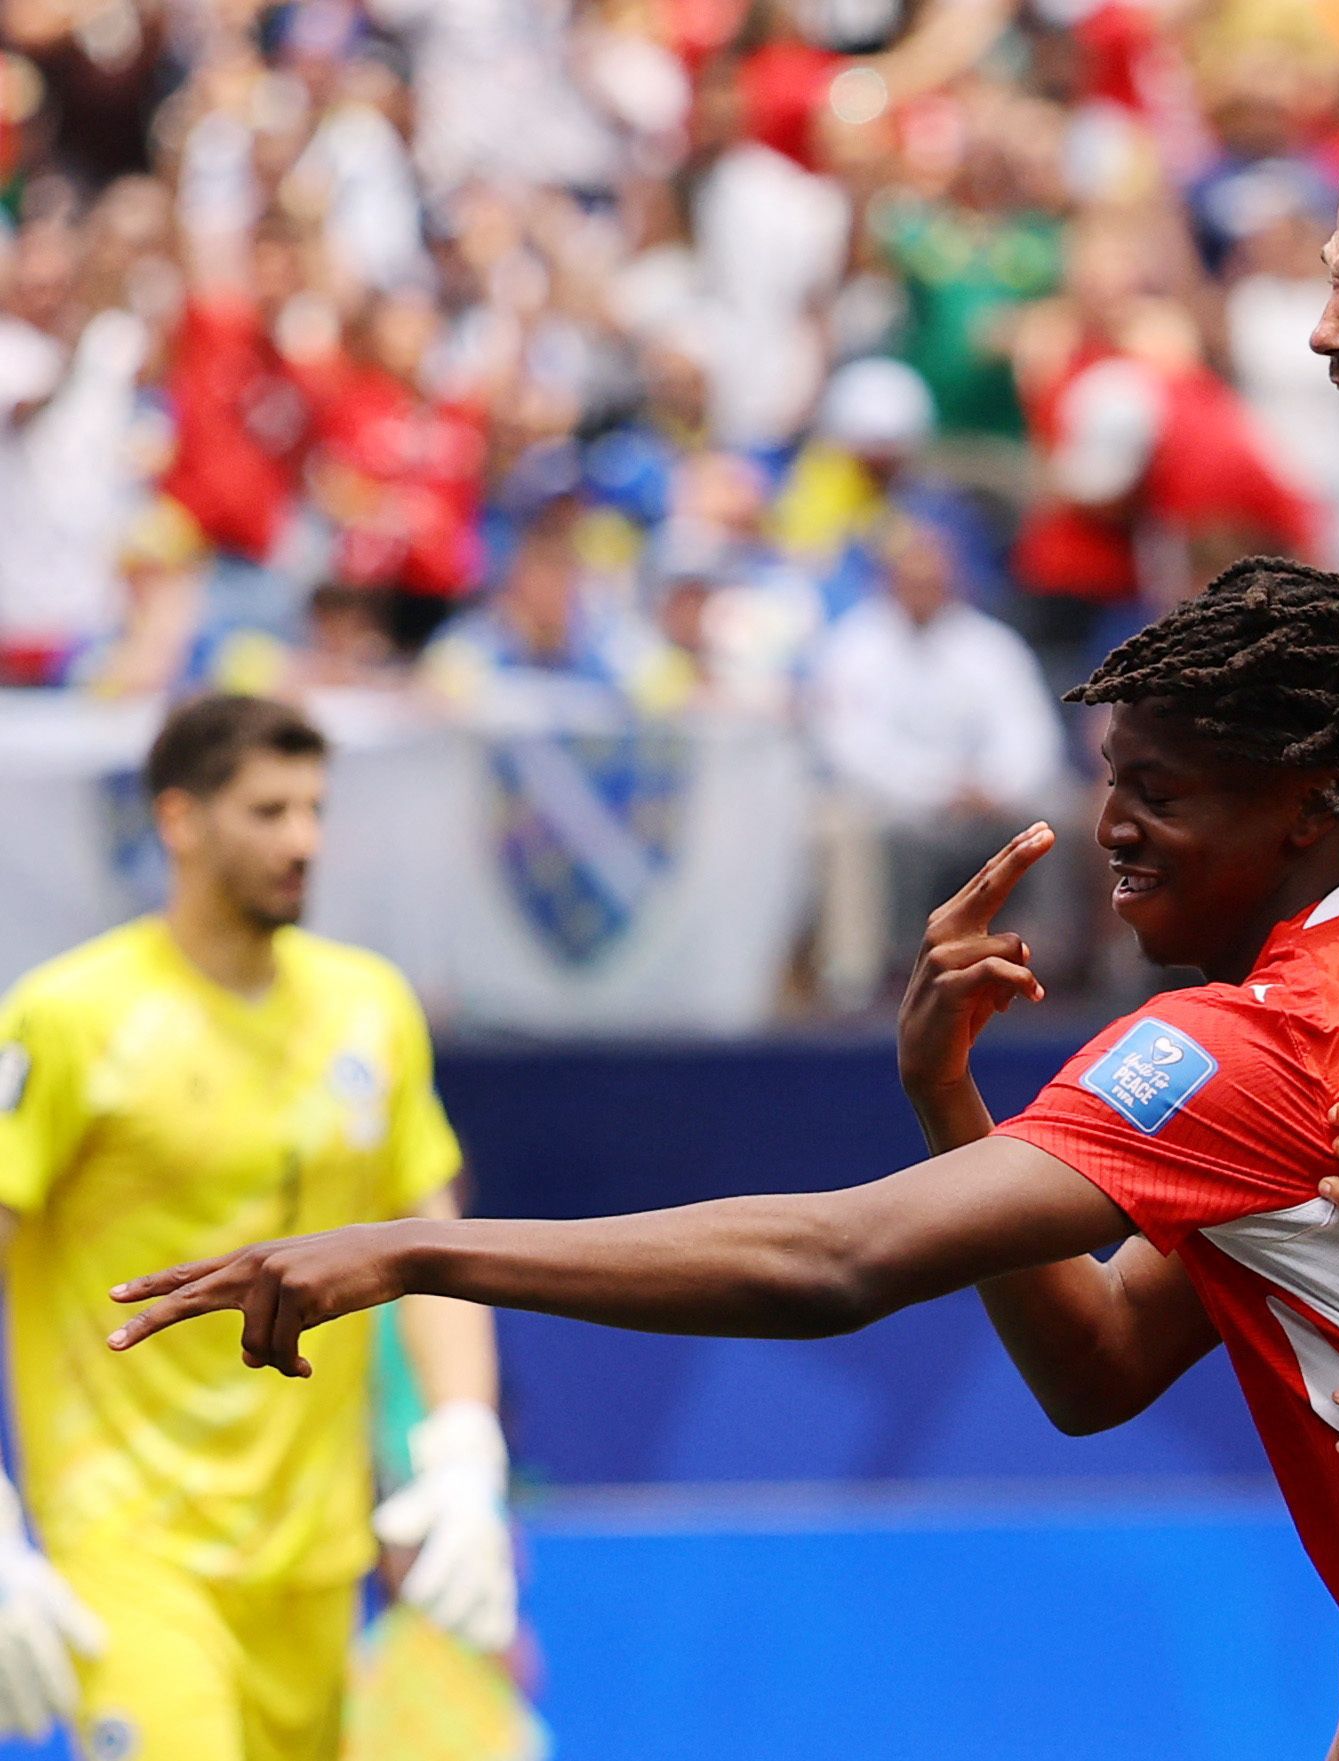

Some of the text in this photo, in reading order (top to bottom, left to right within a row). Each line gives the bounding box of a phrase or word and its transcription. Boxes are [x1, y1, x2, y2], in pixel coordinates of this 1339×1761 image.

[1124, 1053, 1155, 1077] Unite
[1112, 1066, 1157, 1105] PEACE
[1112, 1085, 1134, 1107] FIFA
